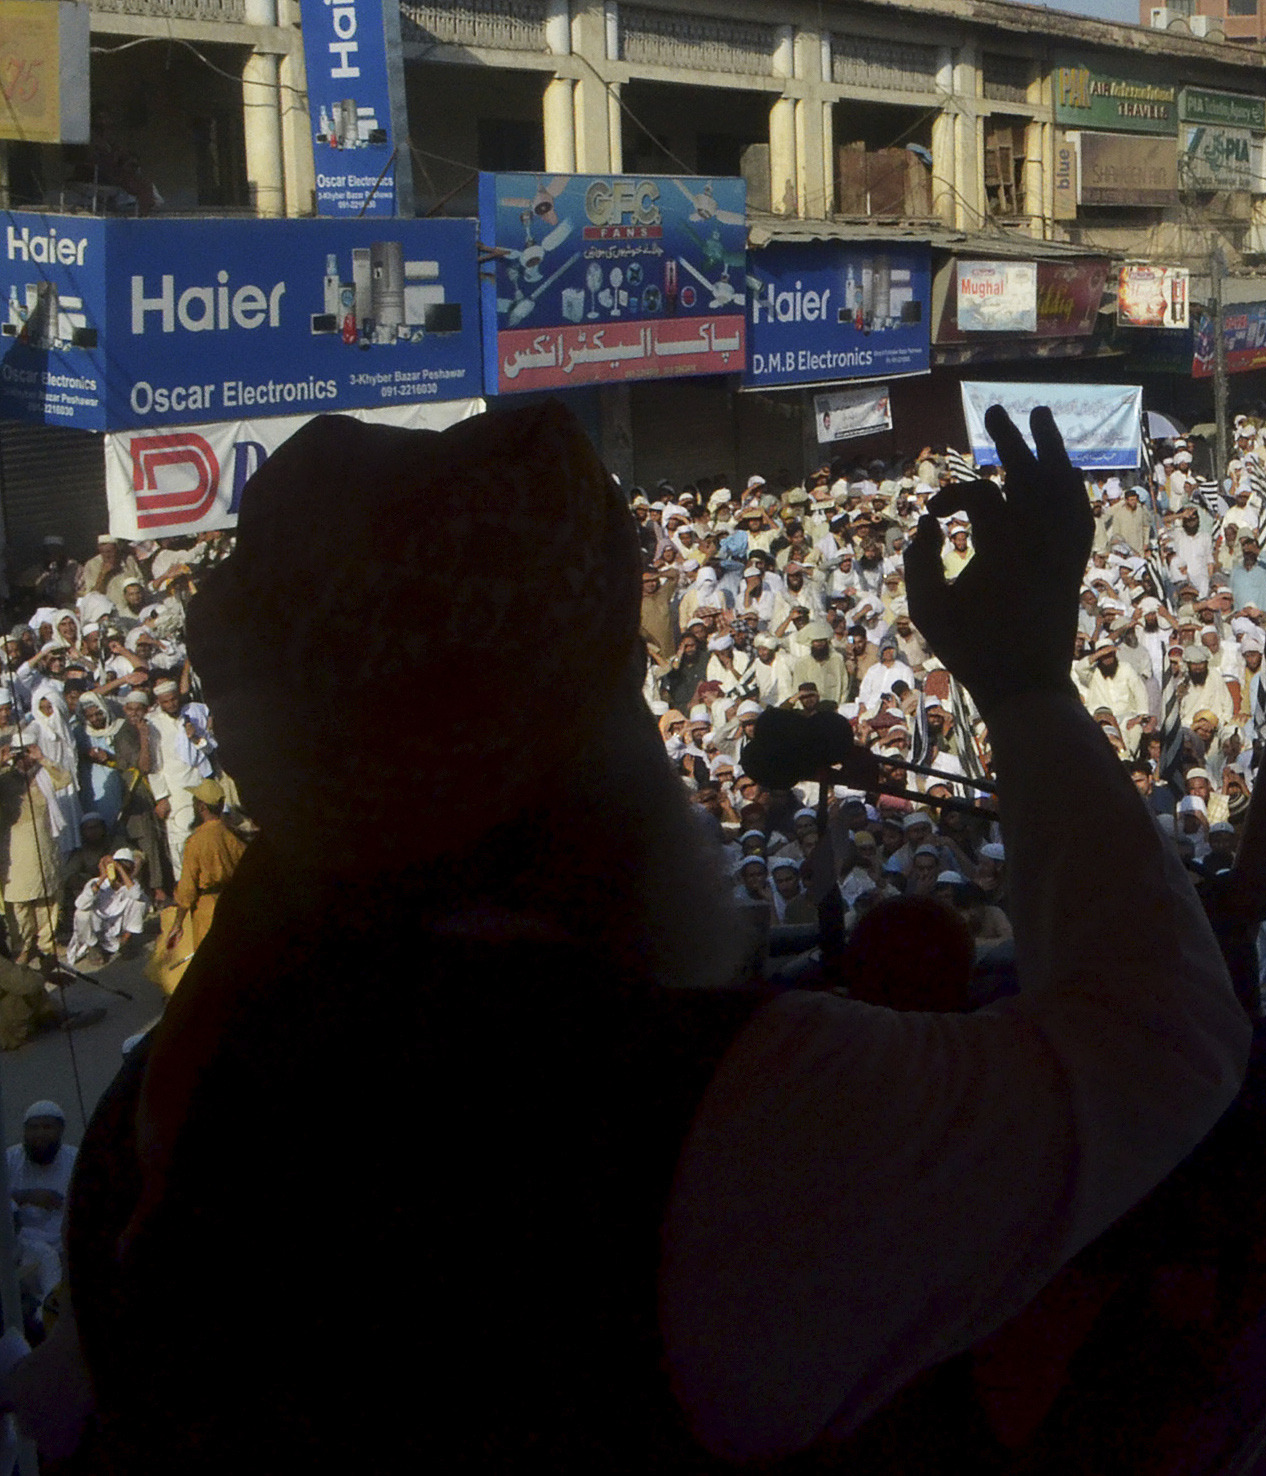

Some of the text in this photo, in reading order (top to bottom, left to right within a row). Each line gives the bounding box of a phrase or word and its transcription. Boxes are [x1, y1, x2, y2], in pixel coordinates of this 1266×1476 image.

[1059, 67, 1091, 109] PAK
[1090, 81, 1111, 96] AIR
[1226, 138, 1249, 163] PIA
[317, 173, 346, 188] Oscar
[1057, 148, 1070, 190] blue
[7, 226, 88, 266] Haier
[600, 228, 648, 238] FANS
[131, 270, 286, 335] Haier
[753, 280, 831, 324] Haier
[961, 278, 1004, 299] Mughal
[654, 322, 741, 364] پاک
[349, 368, 466, 387] 3-Khyber Bazar Peshawar
[753, 347, 873, 375] D.M.B Electronics
[41, 371, 97, 391] Electronics
[130, 376, 338, 415] Oscar Electronics
